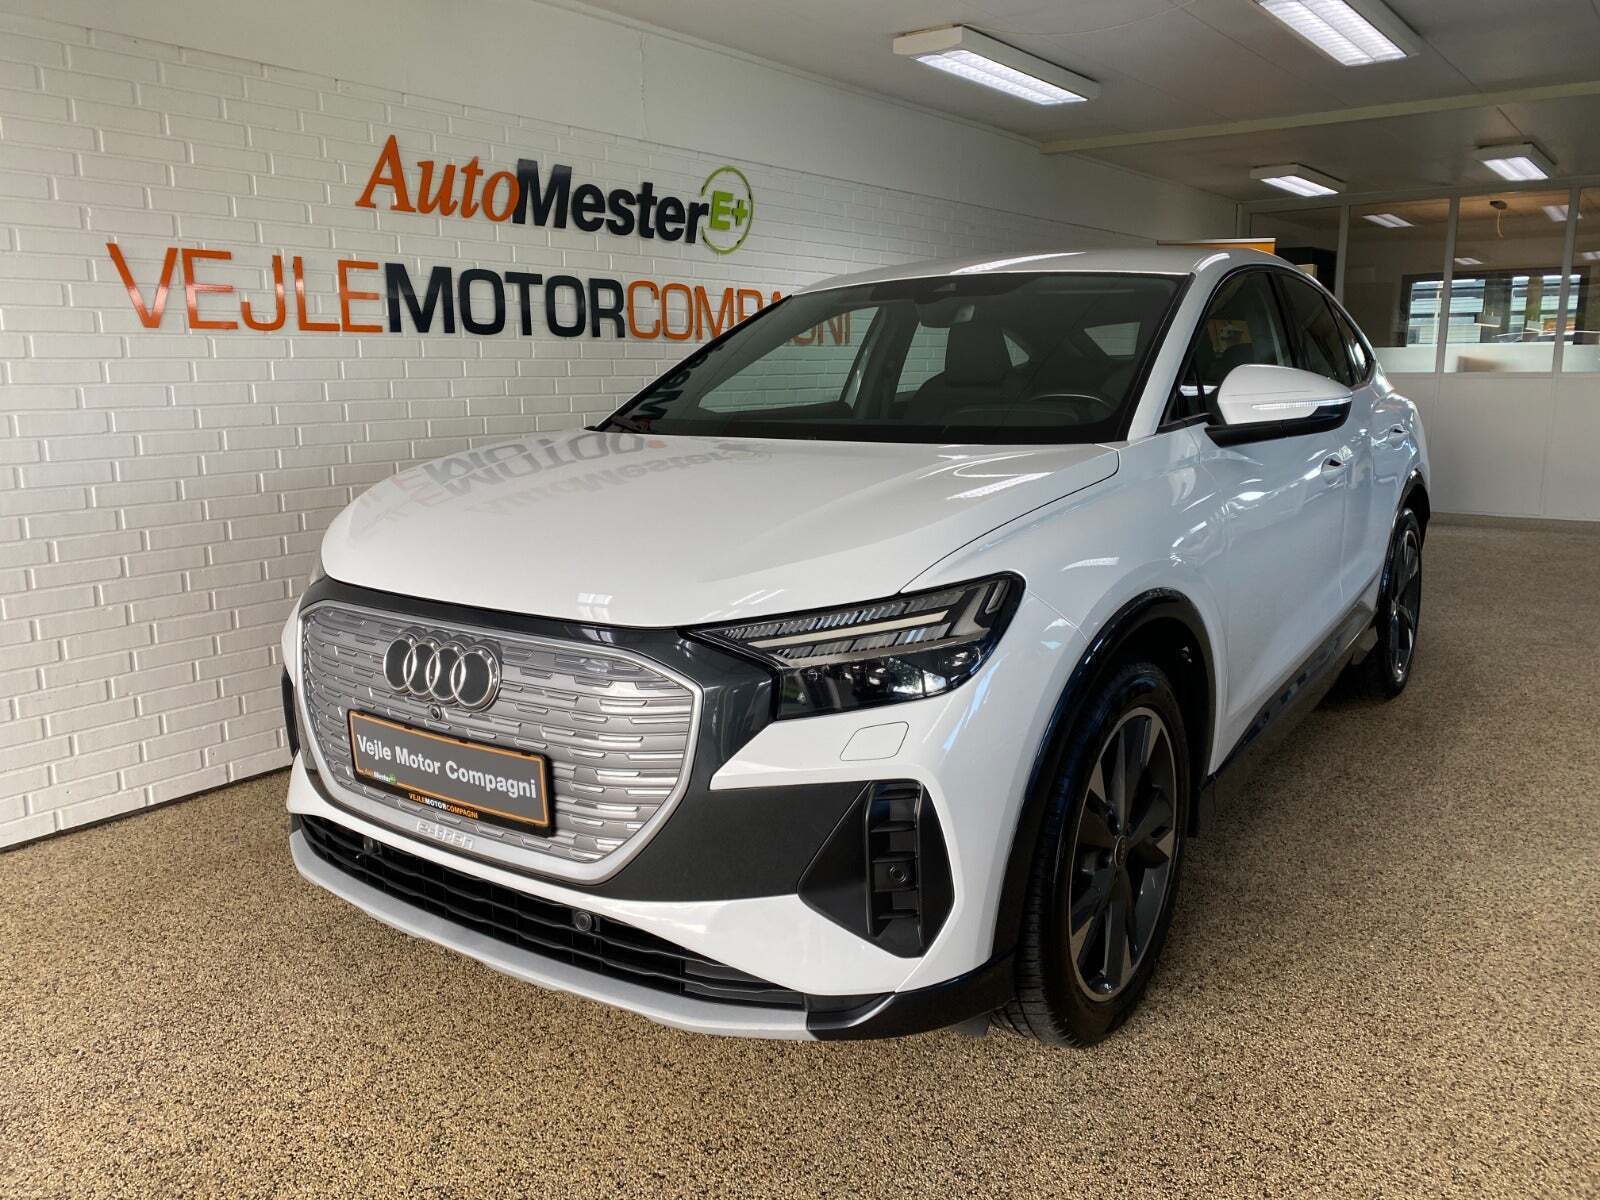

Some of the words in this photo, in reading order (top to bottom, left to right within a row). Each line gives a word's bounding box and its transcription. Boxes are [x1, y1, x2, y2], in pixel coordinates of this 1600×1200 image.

[355, 134, 709, 244] AutoMester
[357, 734, 392, 761] Vejle
[395, 746, 441, 776] Motor
[446, 760, 537, 799] Compagni
